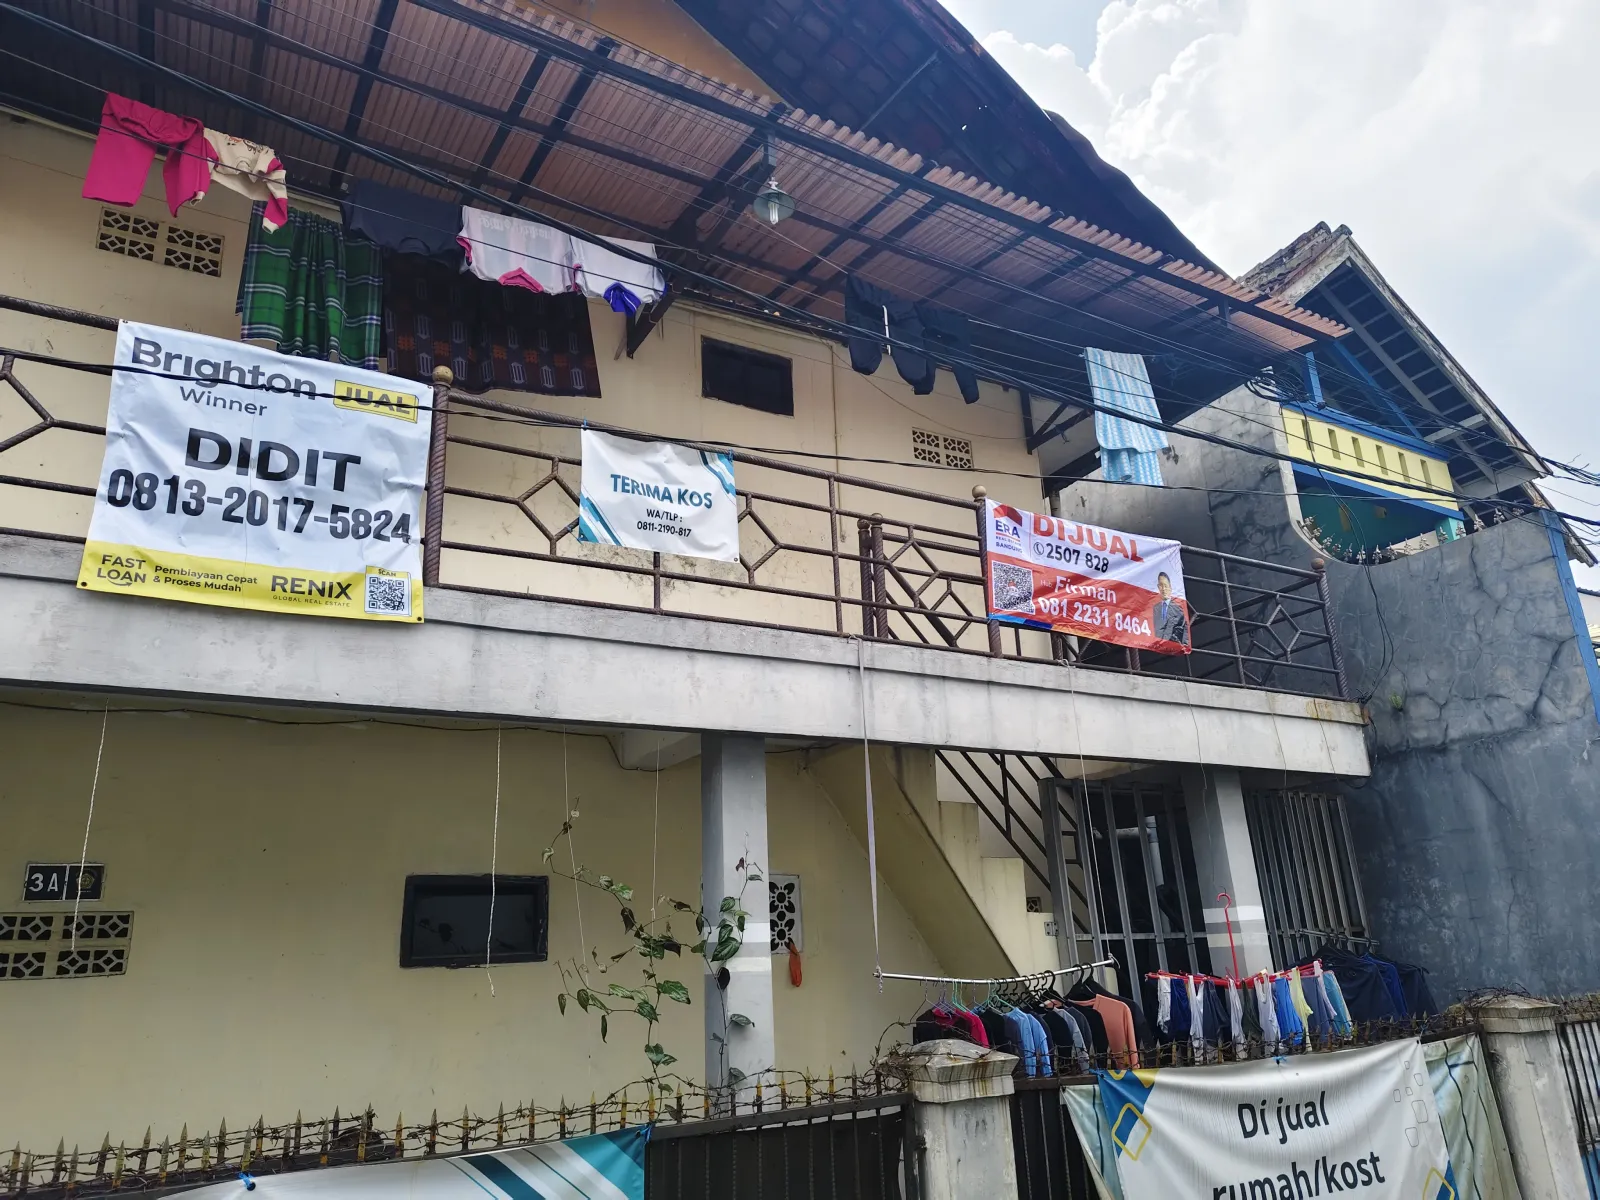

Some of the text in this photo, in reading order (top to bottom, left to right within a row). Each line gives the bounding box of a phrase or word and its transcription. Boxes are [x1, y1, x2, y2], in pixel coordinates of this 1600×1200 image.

[132, 337, 316, 400] Brighton
[180, 386, 267, 416] Winner
[344, 386, 411, 415] JUAL
[185, 427, 361, 492] DIDIT
[610, 473, 713, 509] TERIMA KOS
[107, 469, 412, 543] 0813-2017-5824
[636, 521, 691, 537] 0811-2190-817
[995, 520, 1021, 539] ERA
[1033, 513, 1145, 563] DIJUAL
[101, 554, 147, 569] FAST
[378, 568, 397, 577] SCAN
[1046, 543, 1110, 573] 2507 828
[97, 568, 147, 584] LOAN
[154, 565, 258, 584] Pembiayaan Cepat
[164, 577, 202, 588] Proses
[204, 581, 242, 592] Mudah
[270, 575, 353, 600] RENIX
[272, 594, 302, 603] GLOBAL
[324, 600, 351, 608] ESTATE
[1054, 575, 1117, 604] Firman
[1038, 597, 1151, 636] 081 2231 8464
[1276, 1091, 1330, 1145] jual
